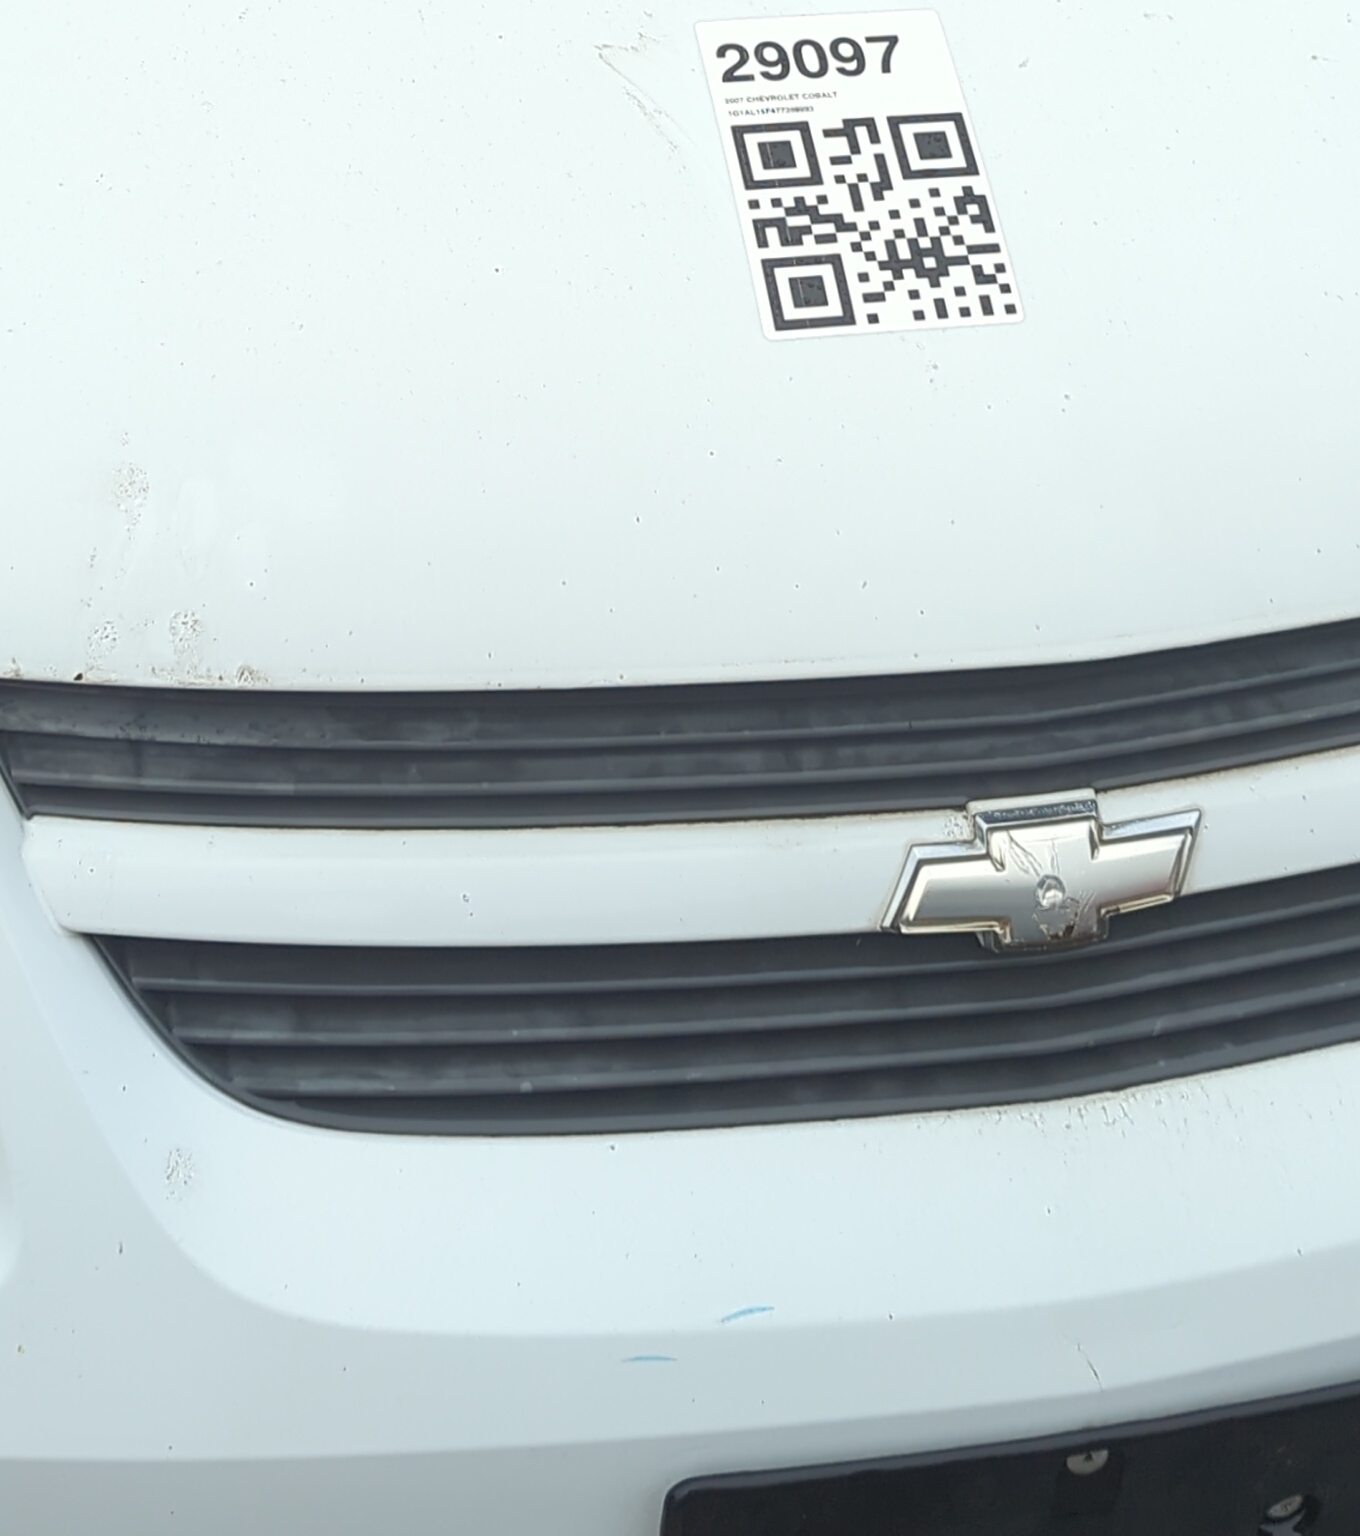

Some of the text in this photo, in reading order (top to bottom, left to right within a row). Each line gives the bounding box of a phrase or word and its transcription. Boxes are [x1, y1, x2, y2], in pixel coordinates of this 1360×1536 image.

[716, 35, 899, 83] 29097
[746, 93, 799, 103] CHEVROLET
[802, 91, 838, 100] COBALT
